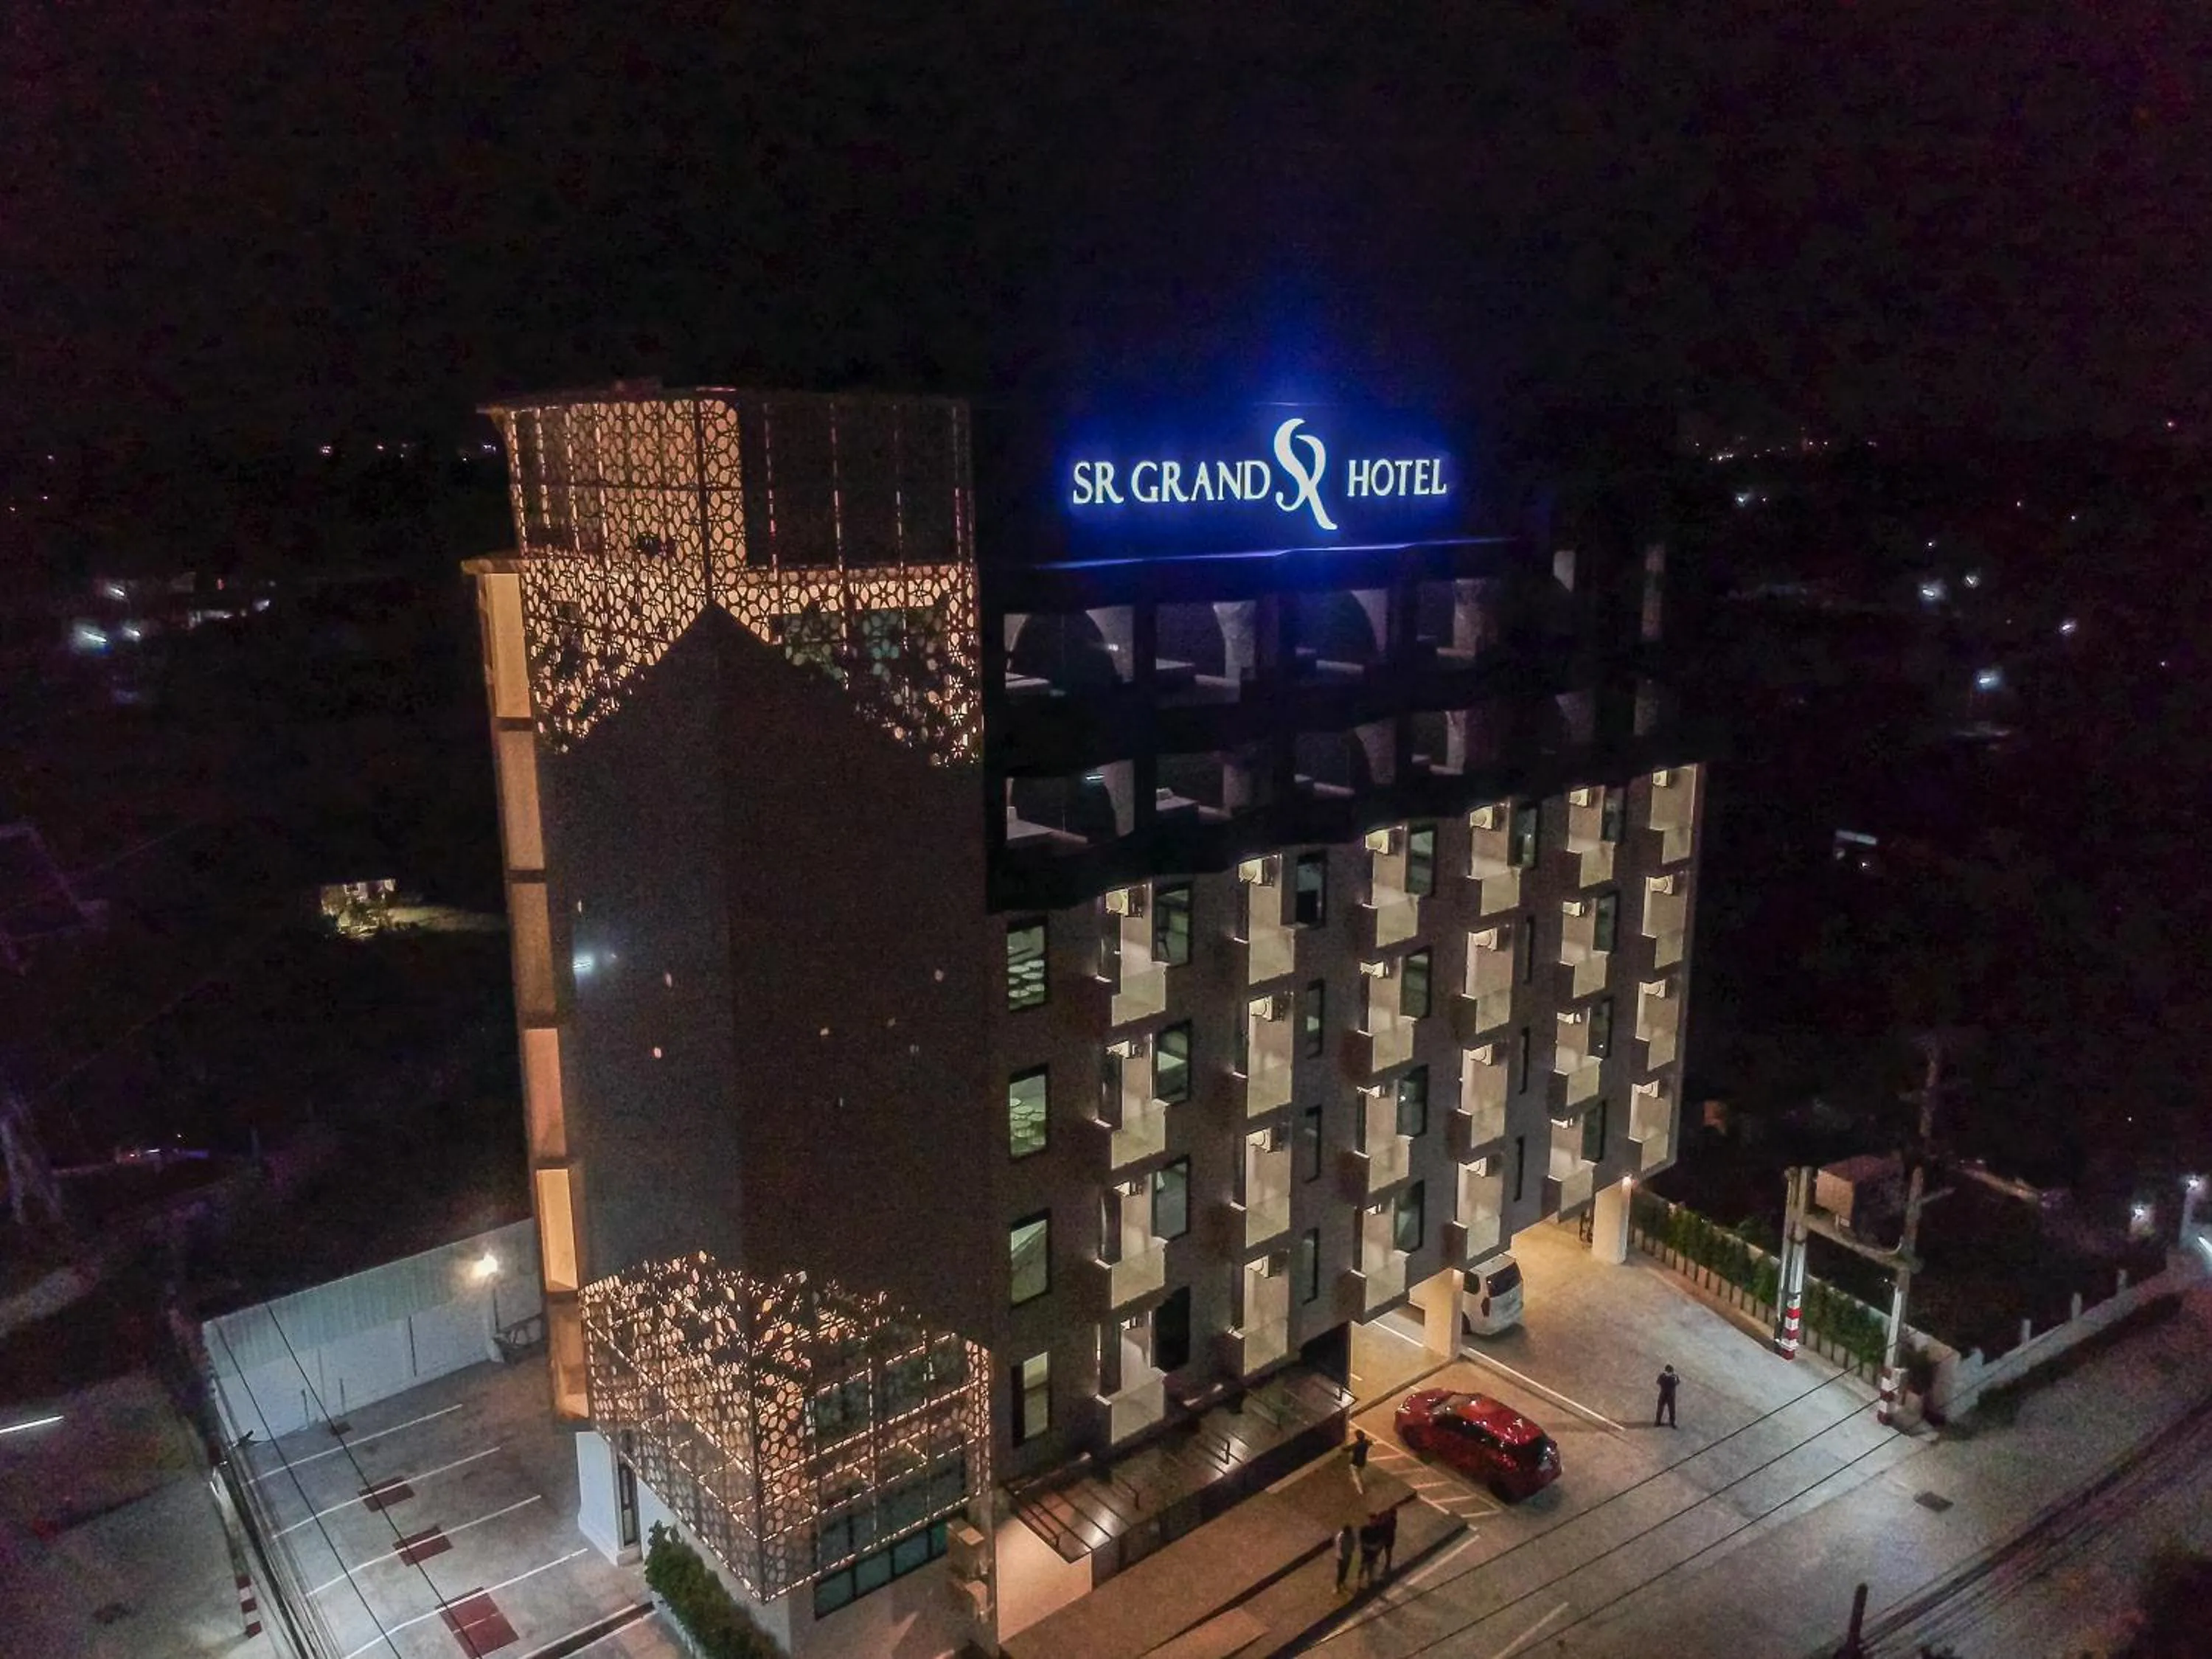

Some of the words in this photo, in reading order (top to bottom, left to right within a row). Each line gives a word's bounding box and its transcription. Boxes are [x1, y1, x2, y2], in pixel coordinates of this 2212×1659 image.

[1072, 461, 1124, 504] SR
[1130, 460, 1270, 504] GRAND
[1347, 459, 1447, 497] HOTEL
